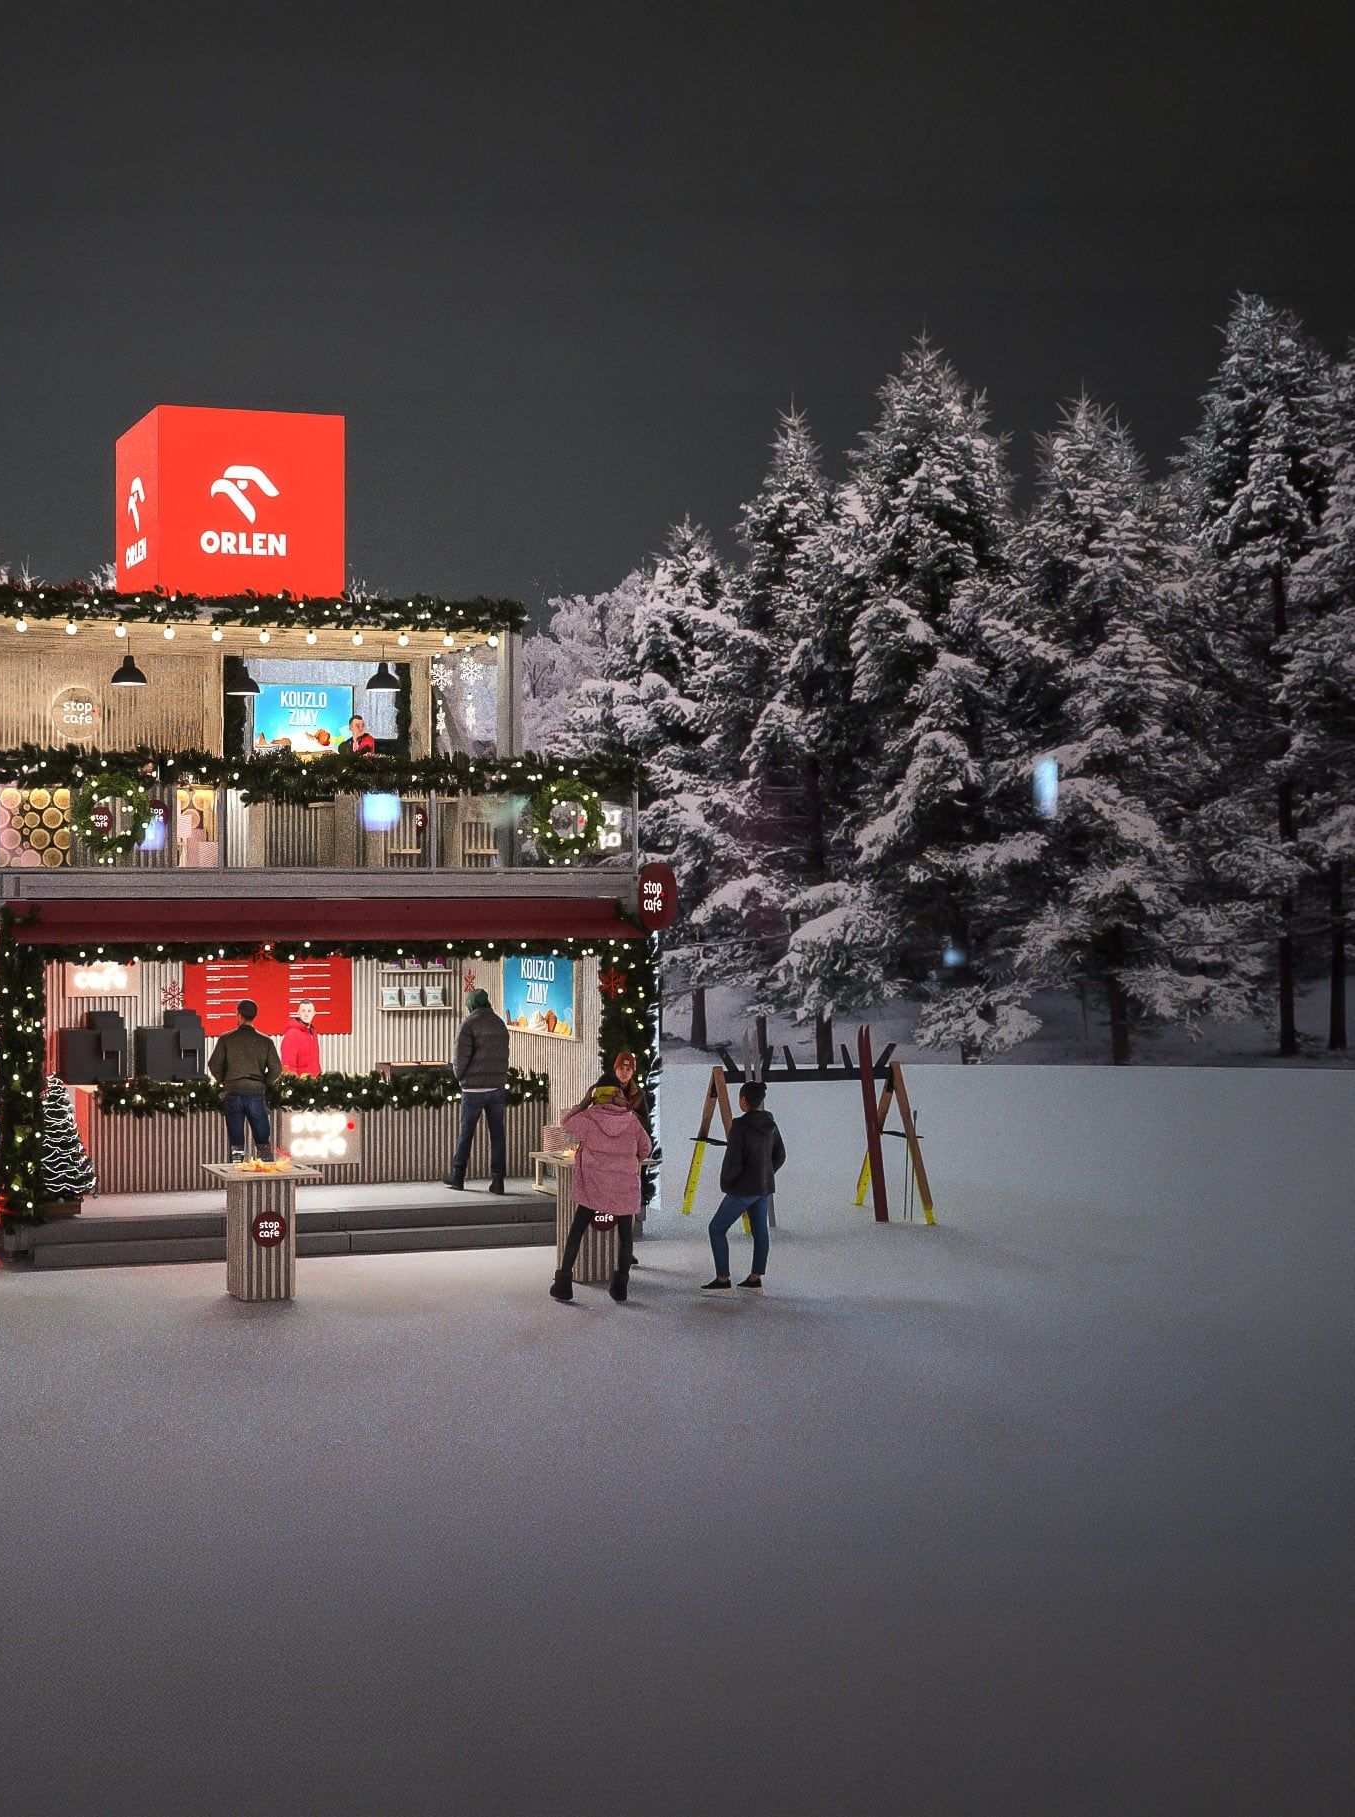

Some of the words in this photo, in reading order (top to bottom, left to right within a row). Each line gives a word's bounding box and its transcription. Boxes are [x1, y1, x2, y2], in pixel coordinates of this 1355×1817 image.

[200, 530, 287, 556] ORLEN
[125, 536, 147, 569] ORLEN
[280, 690, 327, 708] KOUZLO
[63, 713, 93, 725] cafe
[288, 709, 319, 726] ZIMY
[643, 896, 662, 914] cafe
[520, 958, 555, 982] KOUZLO
[526, 981, 549, 1005] ZIMY
[290, 1134, 347, 1159] cafe
[594, 1213, 613, 1222] cafe
[259, 1229, 280, 1239] cafe
